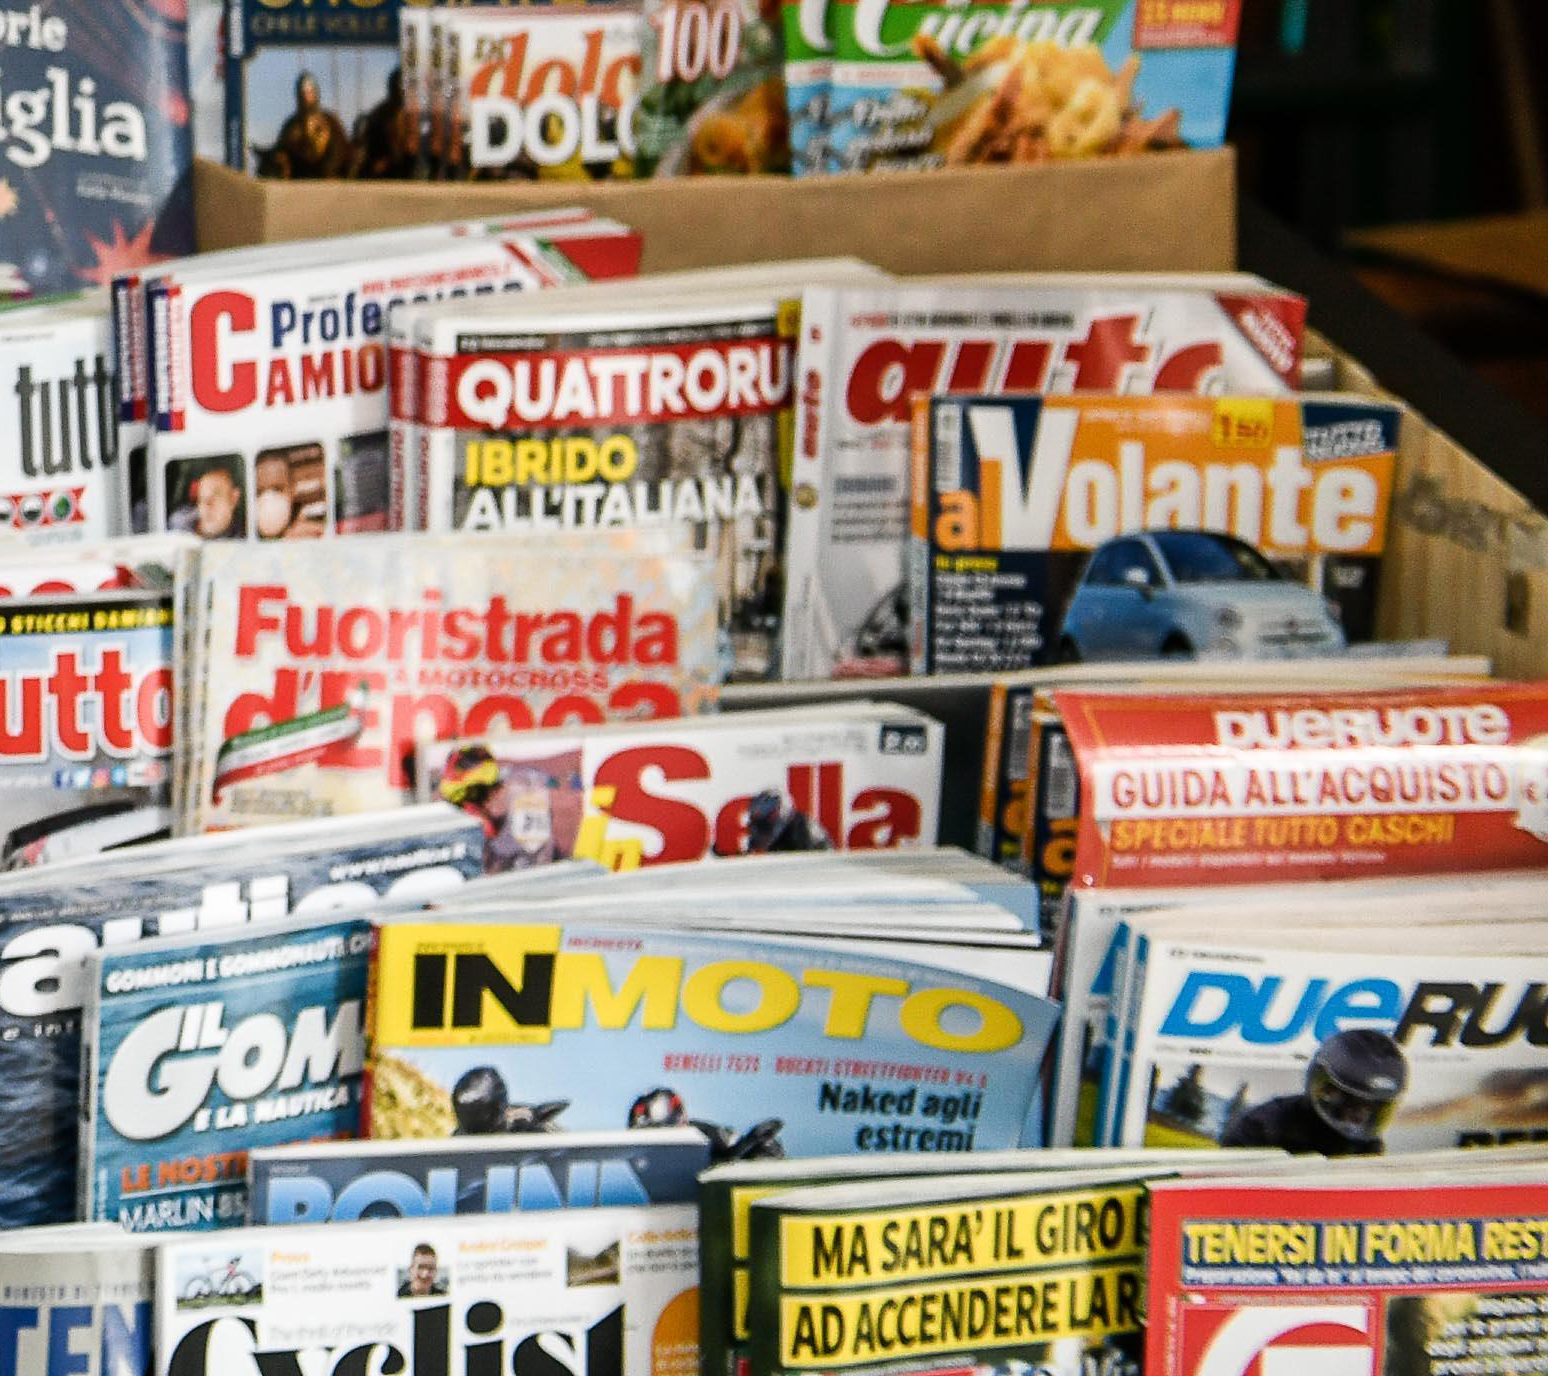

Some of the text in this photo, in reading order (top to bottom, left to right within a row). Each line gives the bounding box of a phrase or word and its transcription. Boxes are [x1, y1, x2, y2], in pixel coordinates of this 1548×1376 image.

[465, 433, 638, 487] IBRIDO
[970, 406, 1379, 552] Volante
[465, 477, 762, 530] ALL'ITALIANA
[234, 583, 681, 668] Fuoristrada
[1111, 762, 1510, 810] GUIDA ALL'ACQUISTO
[1113, 814, 1454, 850] SPECIALE TUTTO CASCHI
[412, 952, 1024, 1053] IN MOTO
[812, 1198, 1125, 1277] MA SARA' IL GIRO
[1185, 1222, 1473, 1266] TENERSI IN FORMA
[793, 1282, 1056, 1357] AD ACCENDERE
